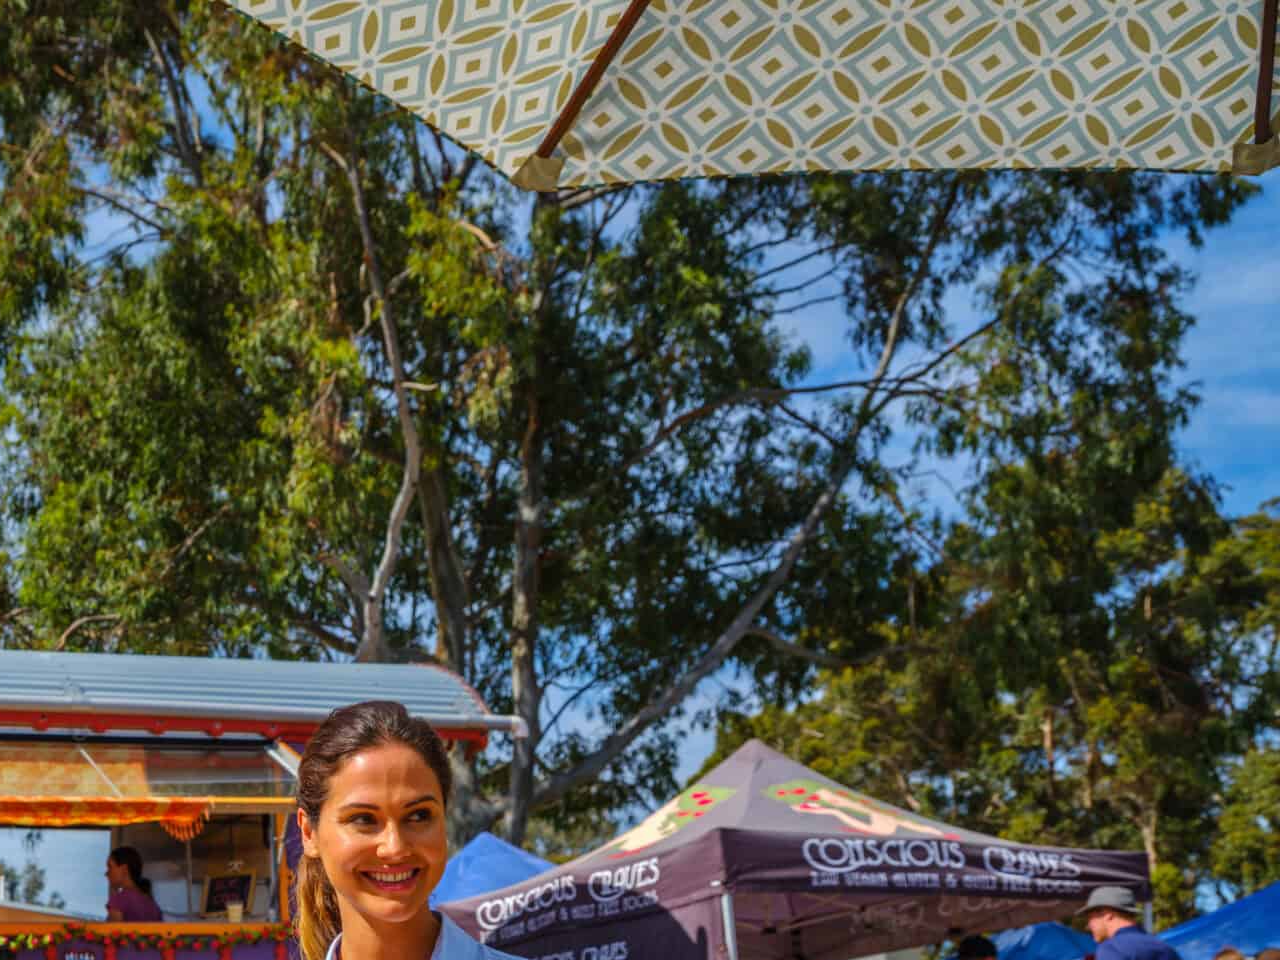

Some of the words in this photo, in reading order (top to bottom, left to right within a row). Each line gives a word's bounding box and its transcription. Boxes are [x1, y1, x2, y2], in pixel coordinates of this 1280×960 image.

[802, 838, 965, 872] CONSCIOUS
[475, 874, 577, 930] CONSCIOUS
[587, 856, 660, 901] CRAVES
